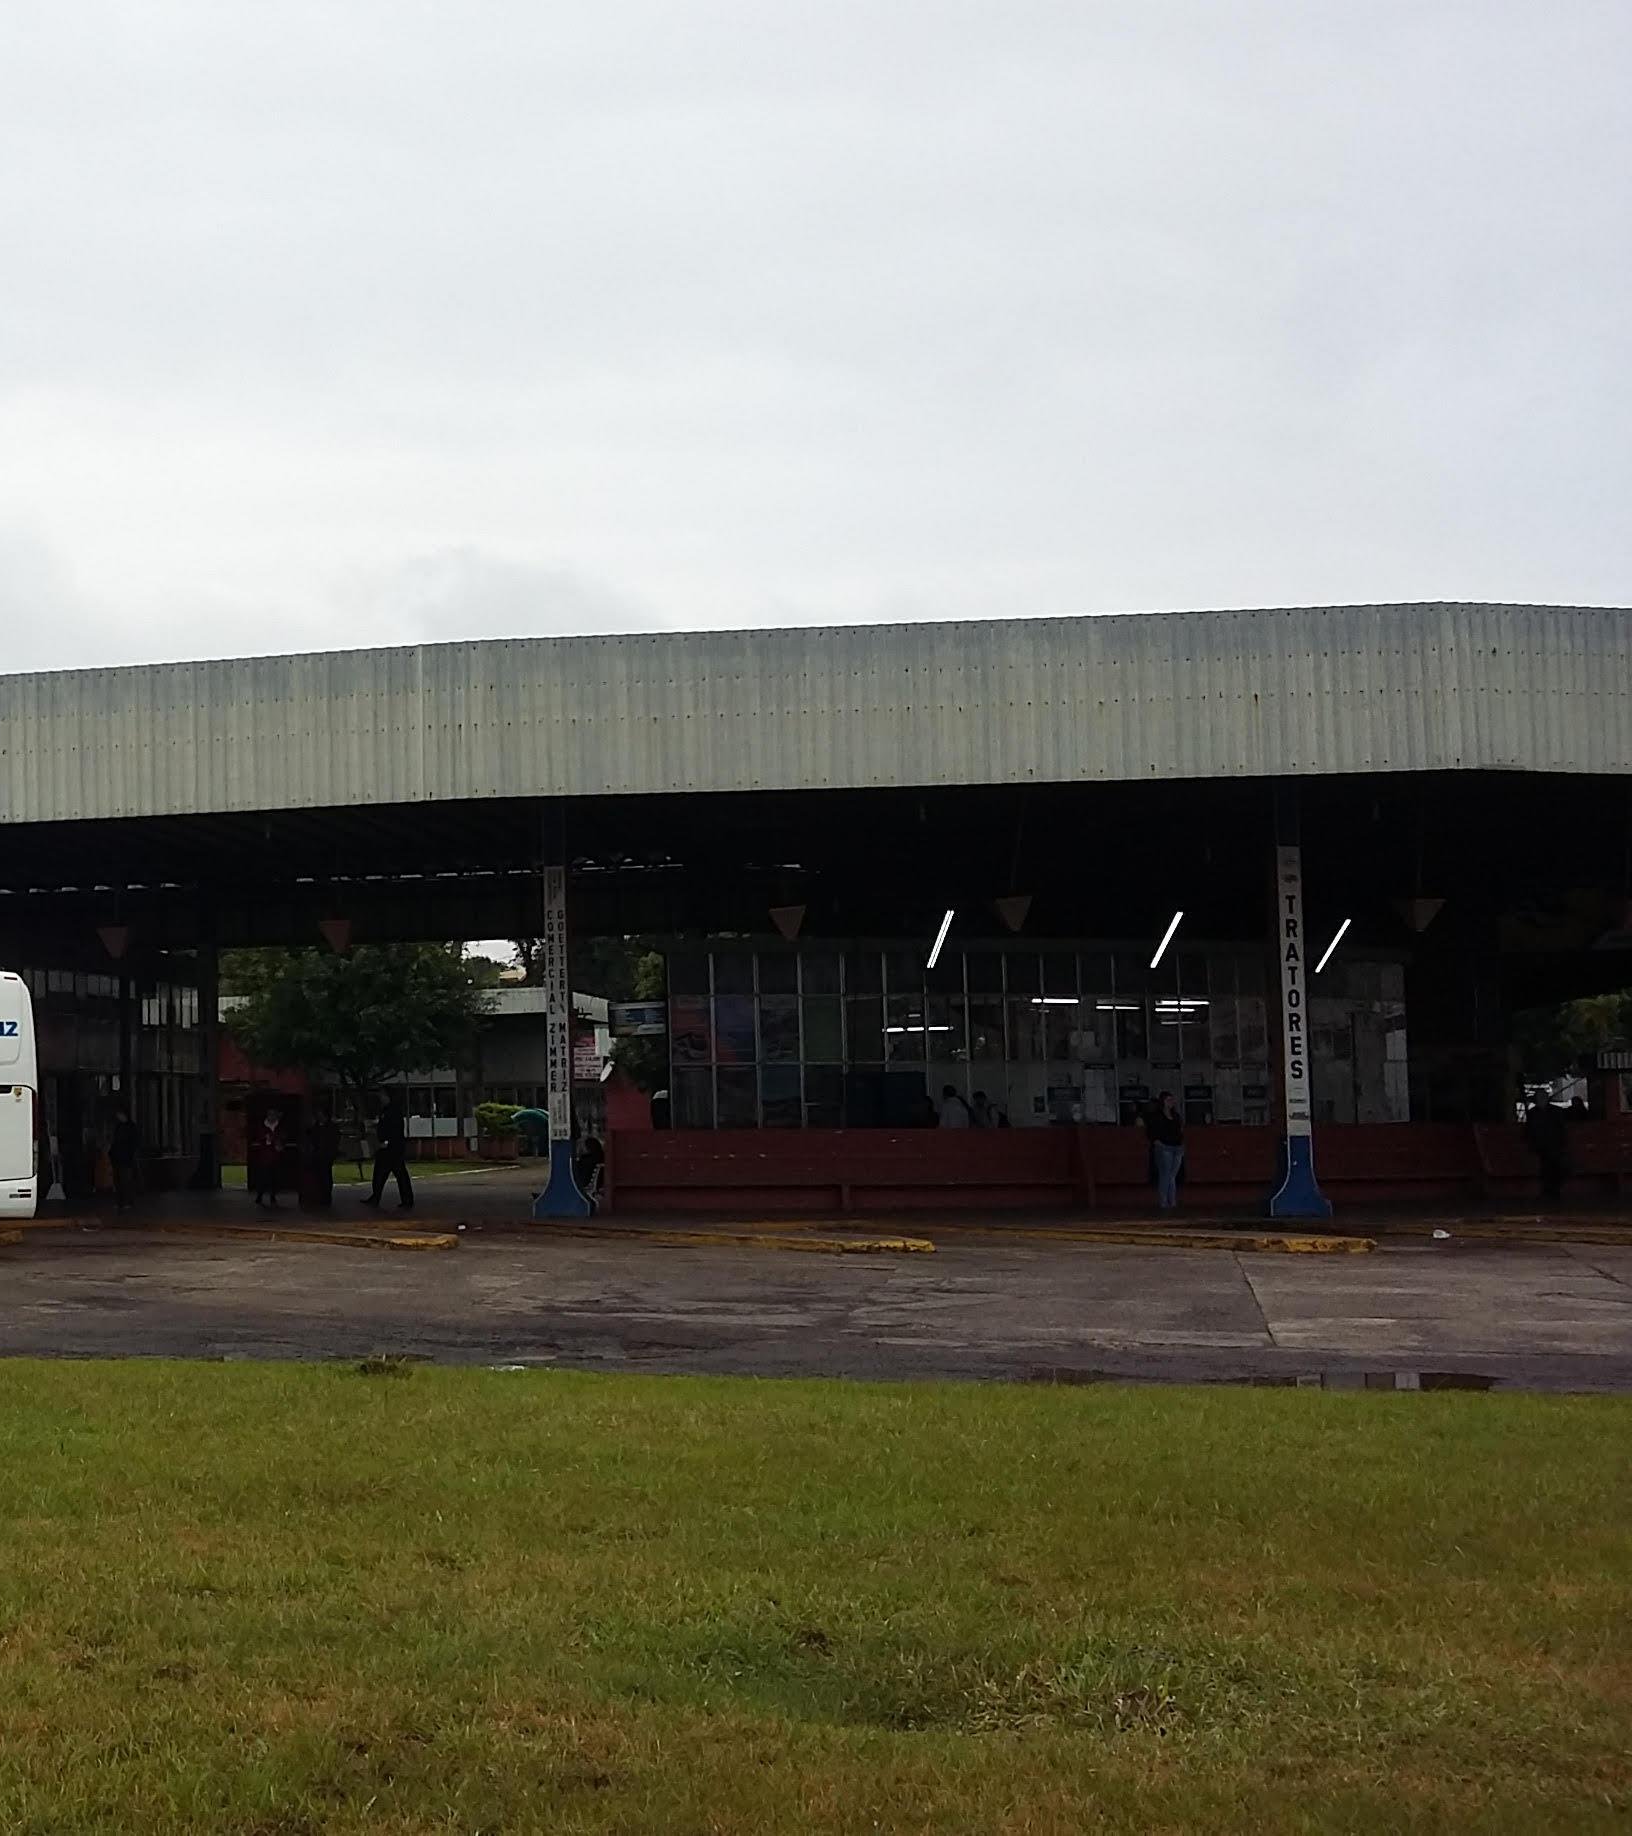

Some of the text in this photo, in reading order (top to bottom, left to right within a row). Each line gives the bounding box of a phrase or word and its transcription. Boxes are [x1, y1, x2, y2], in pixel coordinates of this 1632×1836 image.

[1285, 894, 1303, 1079] TRATORES
[549, 1022, 557, 1092] ZIMMER
[559, 1022, 568, 1092] MATRIZ
